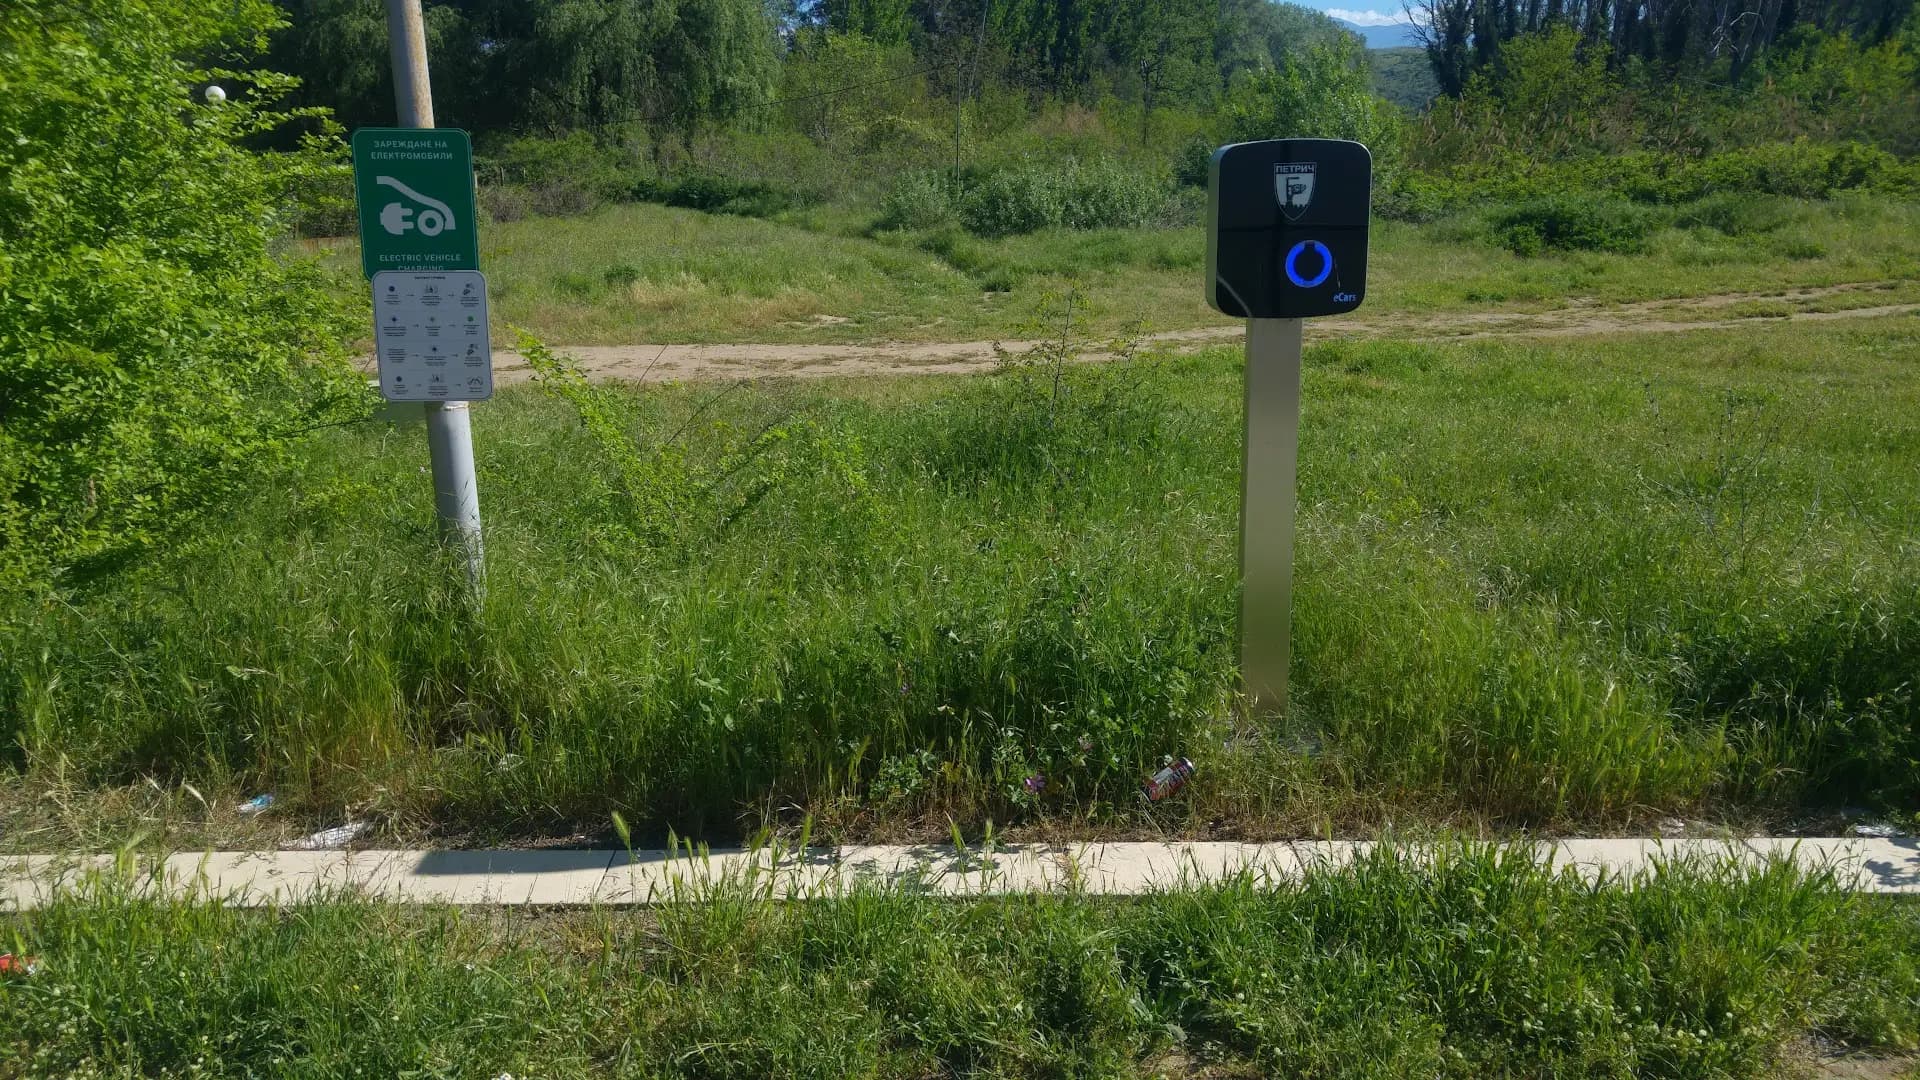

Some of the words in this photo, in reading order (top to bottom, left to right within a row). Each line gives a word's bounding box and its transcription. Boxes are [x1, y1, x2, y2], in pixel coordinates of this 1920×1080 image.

[374, 140, 433, 149] ЗАРЕЖДАНЕ
[434, 140, 448, 148] НА
[371, 151, 453, 160] ЕЛЕКТРОМОБИЛИ
[1275, 165, 1314, 173] ПЕТРИЧ
[379, 254, 421, 262] ELECTRIC
[423, 253, 462, 262] VEHICLE
[1333, 292, 1357, 302] eCars
